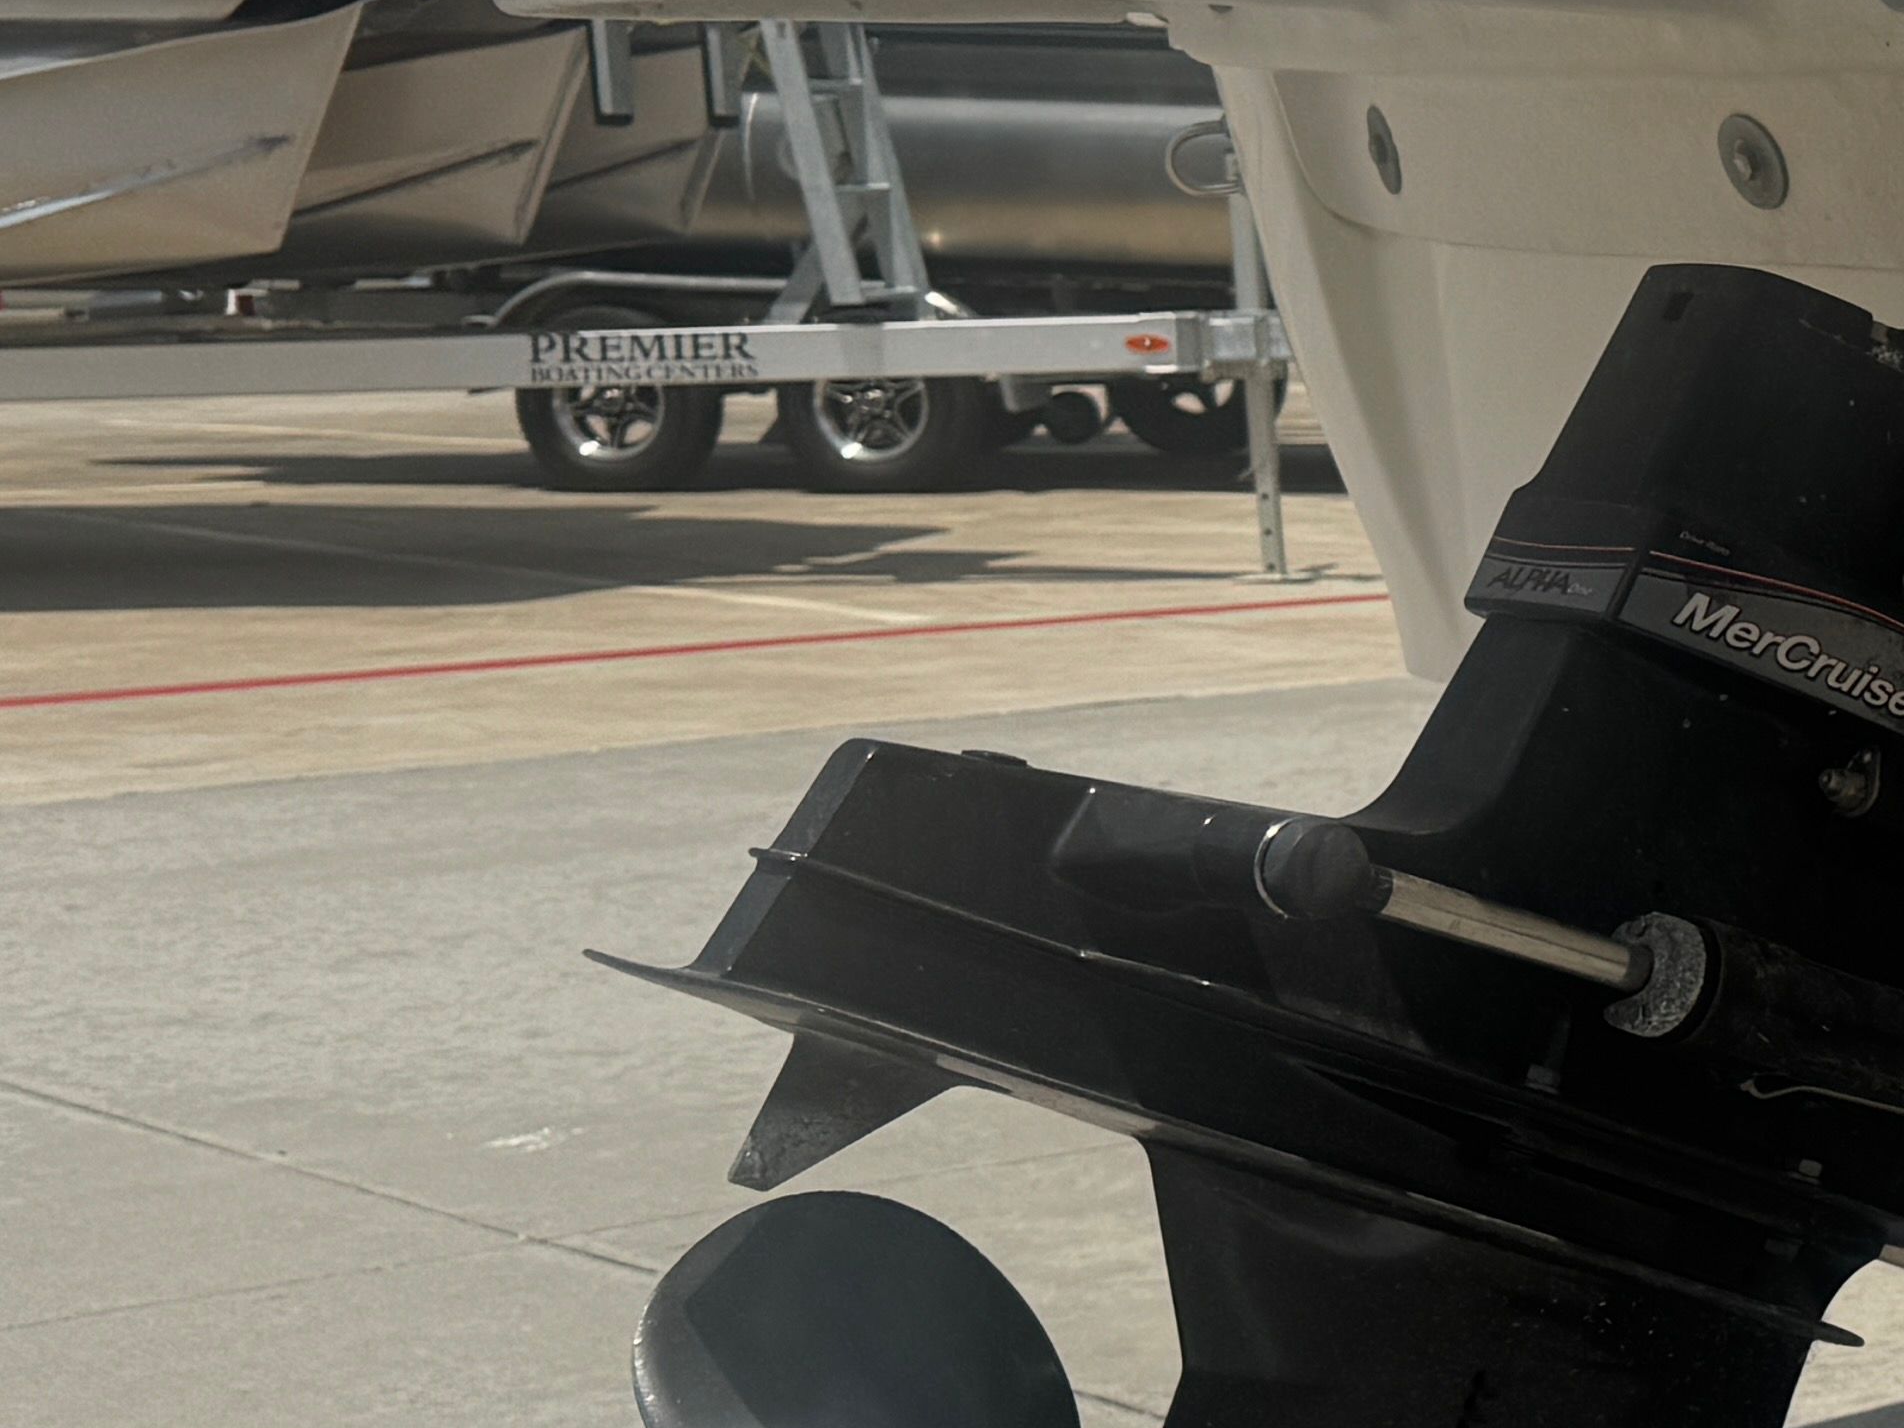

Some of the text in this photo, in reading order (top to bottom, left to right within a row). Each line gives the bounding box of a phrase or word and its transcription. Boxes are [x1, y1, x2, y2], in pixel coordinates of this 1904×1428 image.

[529, 331, 756, 363] PREMIER
[530, 359, 760, 384] BOATING CENTERS
[1486, 566, 1570, 595] ALPHA
